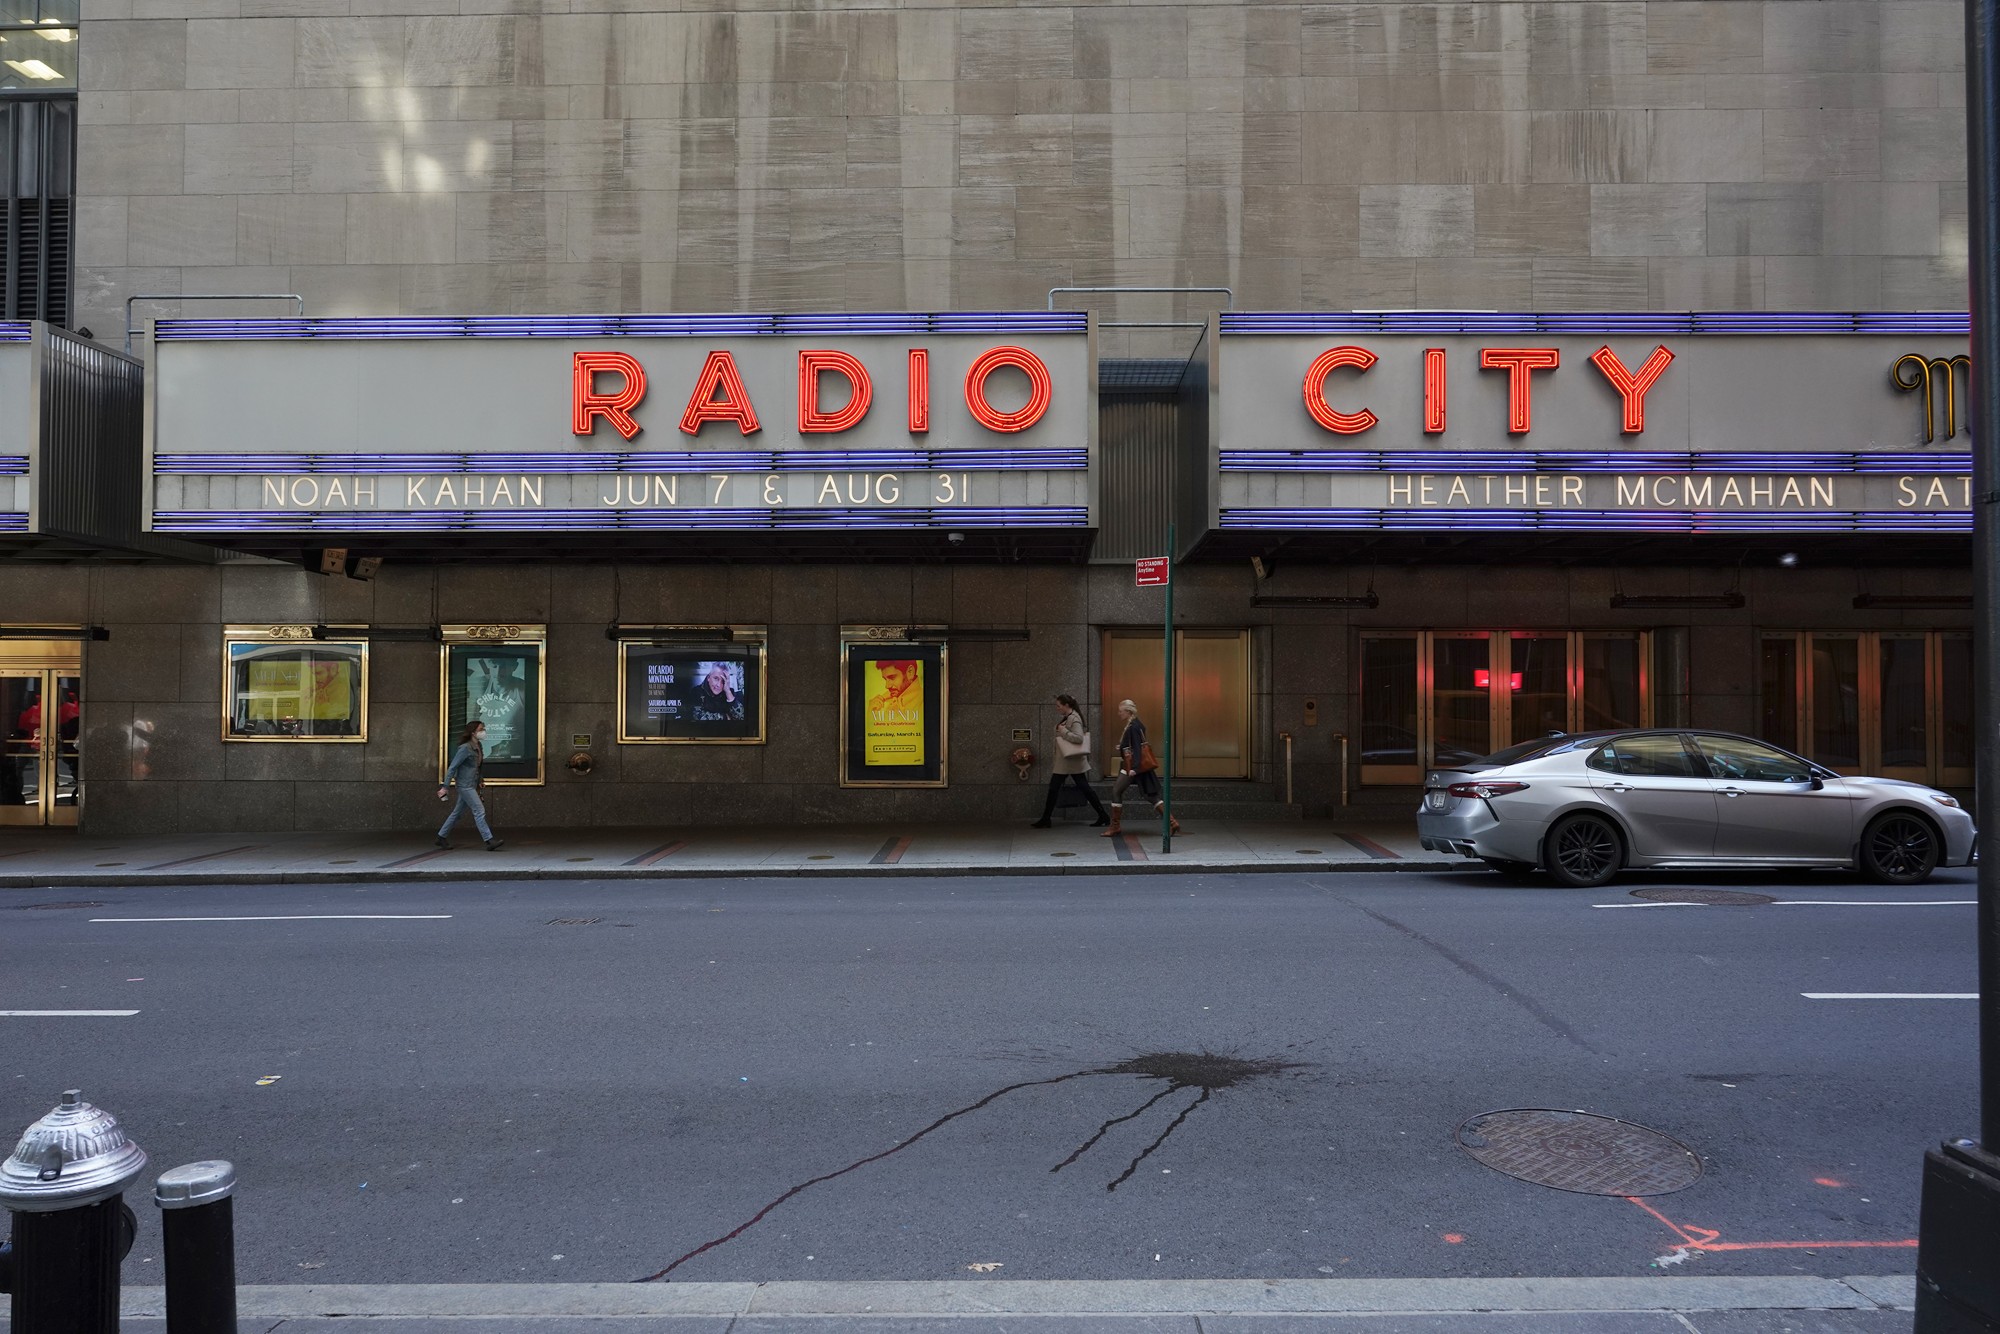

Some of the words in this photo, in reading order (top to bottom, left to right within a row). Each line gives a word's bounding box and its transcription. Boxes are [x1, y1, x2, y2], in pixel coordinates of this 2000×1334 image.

[573, 346, 1052, 441] RADIO
[1303, 344, 1676, 435] CITY
[264, 477, 347, 507] NOAH
[407, 476, 542, 506] KAHAN
[603, 475, 676, 505] JUN
[711, 475, 729, 504] 7
[763, 474, 783, 504] &
[818, 474, 899, 504] AUG
[936, 474, 967, 504] 31
[1390, 475, 1583, 506] HEATHER
[1617, 475, 1834, 507] MCMAHAN
[648, 665, 674, 674] RICARDO
[648, 675, 674, 684] MONTANER
[479, 705, 510, 718] PUTH
